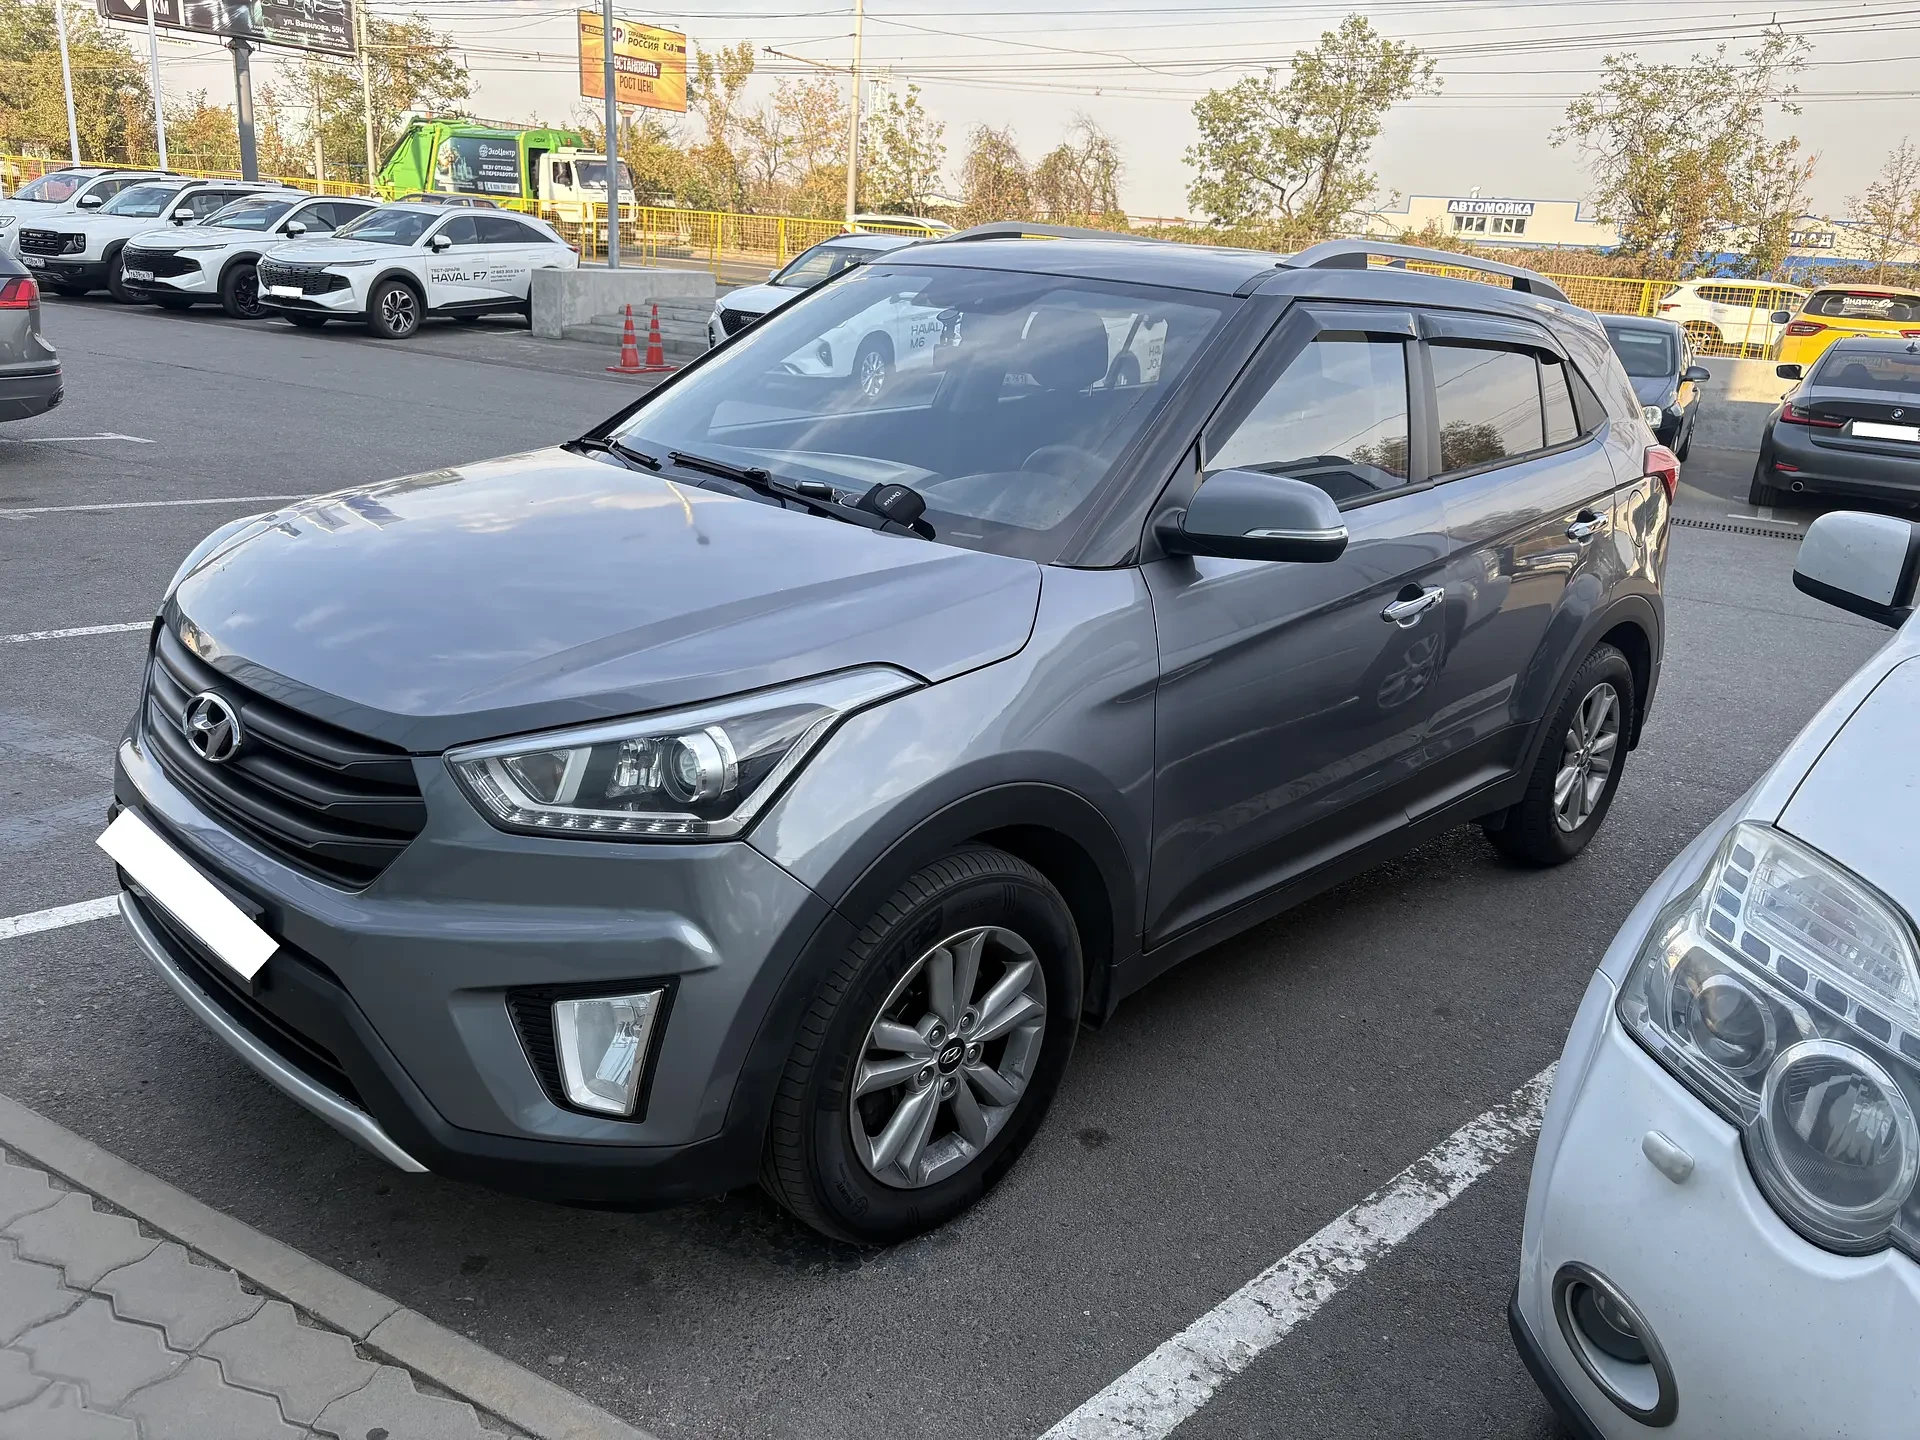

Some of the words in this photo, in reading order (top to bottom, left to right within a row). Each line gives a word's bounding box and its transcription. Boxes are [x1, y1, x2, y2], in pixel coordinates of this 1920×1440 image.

[628, 38, 660, 51] РОССИЯ
[614, 56, 658, 76] ОСТАНОВИТЬ
[620, 76, 636, 90] РОСТ
[637, 79, 654, 93] ЦЕН!
[488, 148, 516, 157] ЭкоЦентр
[1448, 201, 1532, 215] АВТОМОЙКА
[431, 272, 470, 283] HAVAL
[473, 271, 487, 280] F7
[1842, 297, 1878, 306] Яндекс
[911, 322, 941, 336] HAVAL
[910, 337, 925, 349] M6
